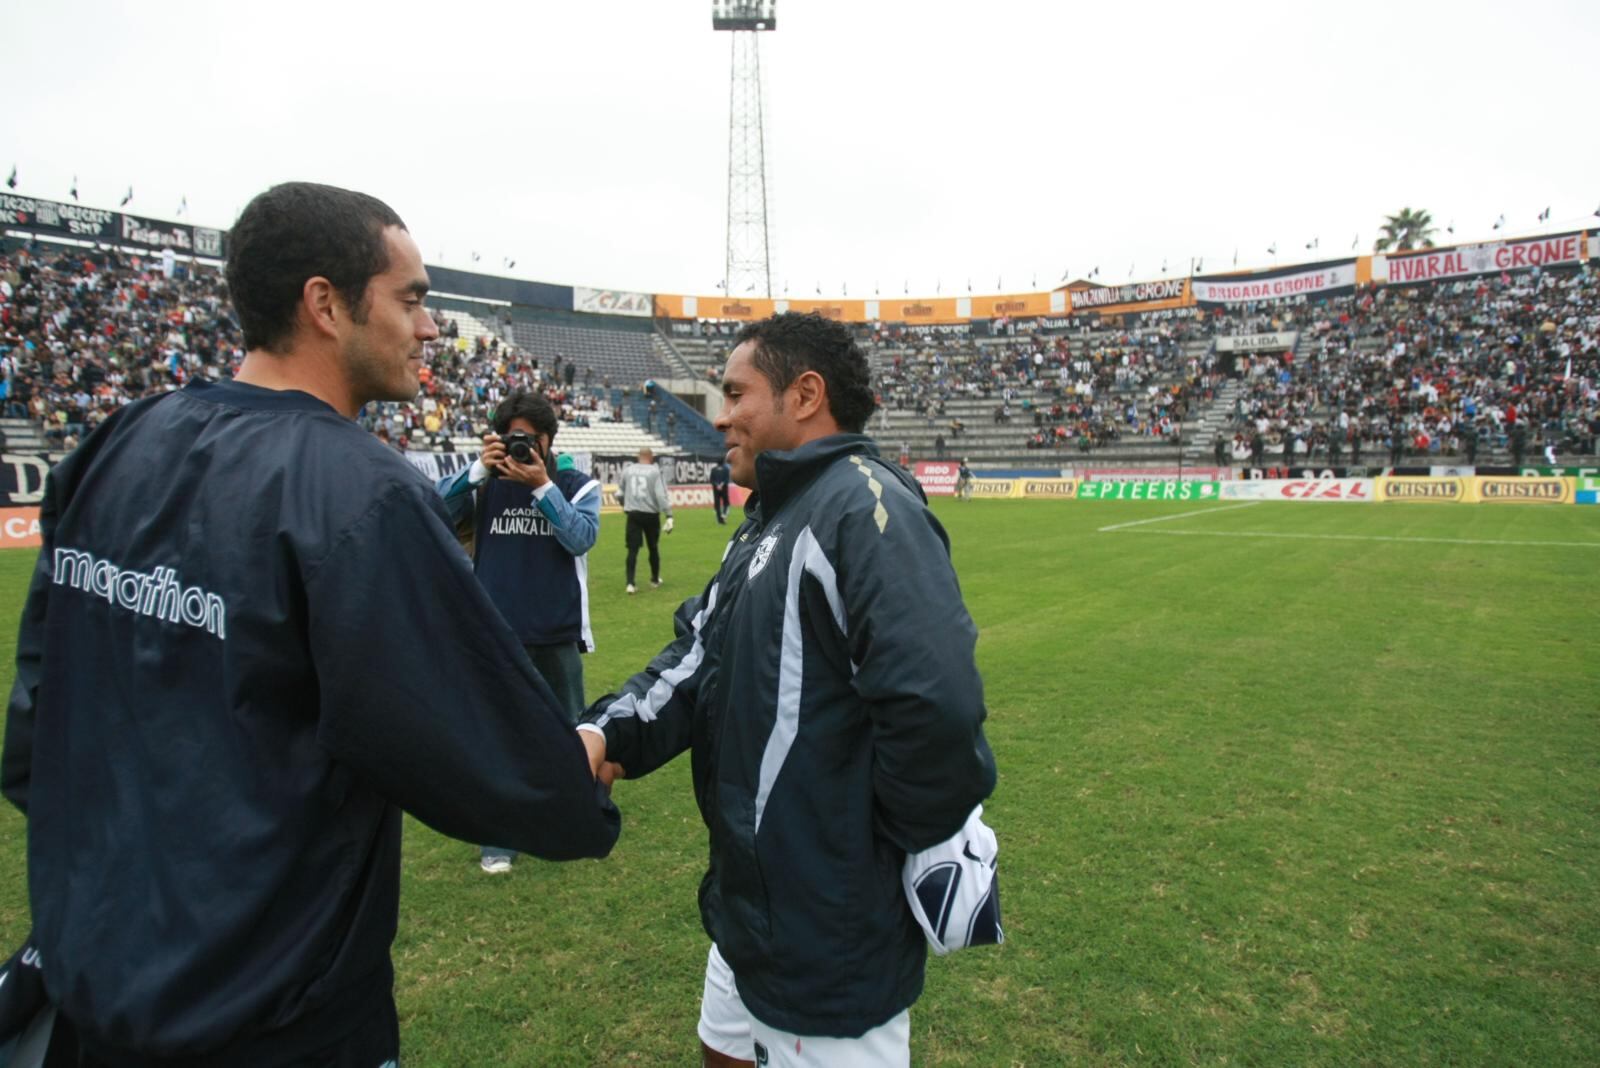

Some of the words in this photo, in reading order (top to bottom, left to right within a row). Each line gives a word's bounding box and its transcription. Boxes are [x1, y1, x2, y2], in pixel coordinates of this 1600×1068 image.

[1389, 253, 1469, 281] HVARAL
[1495, 237, 1576, 269] GRONE
[1135, 281, 1183, 300] GRONE
[1208, 286, 1270, 299] BRIGADA
[1274, 275, 1324, 294] GRONE
[1233, 335, 1279, 348] SALIDA
[631, 475, 649, 498] 12
[968, 483, 1010, 494] RISTAL
[1101, 482, 1192, 499] PIEERS
[1281, 482, 1366, 498] CIAL
[1388, 482, 1455, 497] CRISTAL
[1484, 482, 1560, 497] CRISTAL
[490, 518, 538, 536] ALIANZA
[53, 547, 226, 640] marathon
